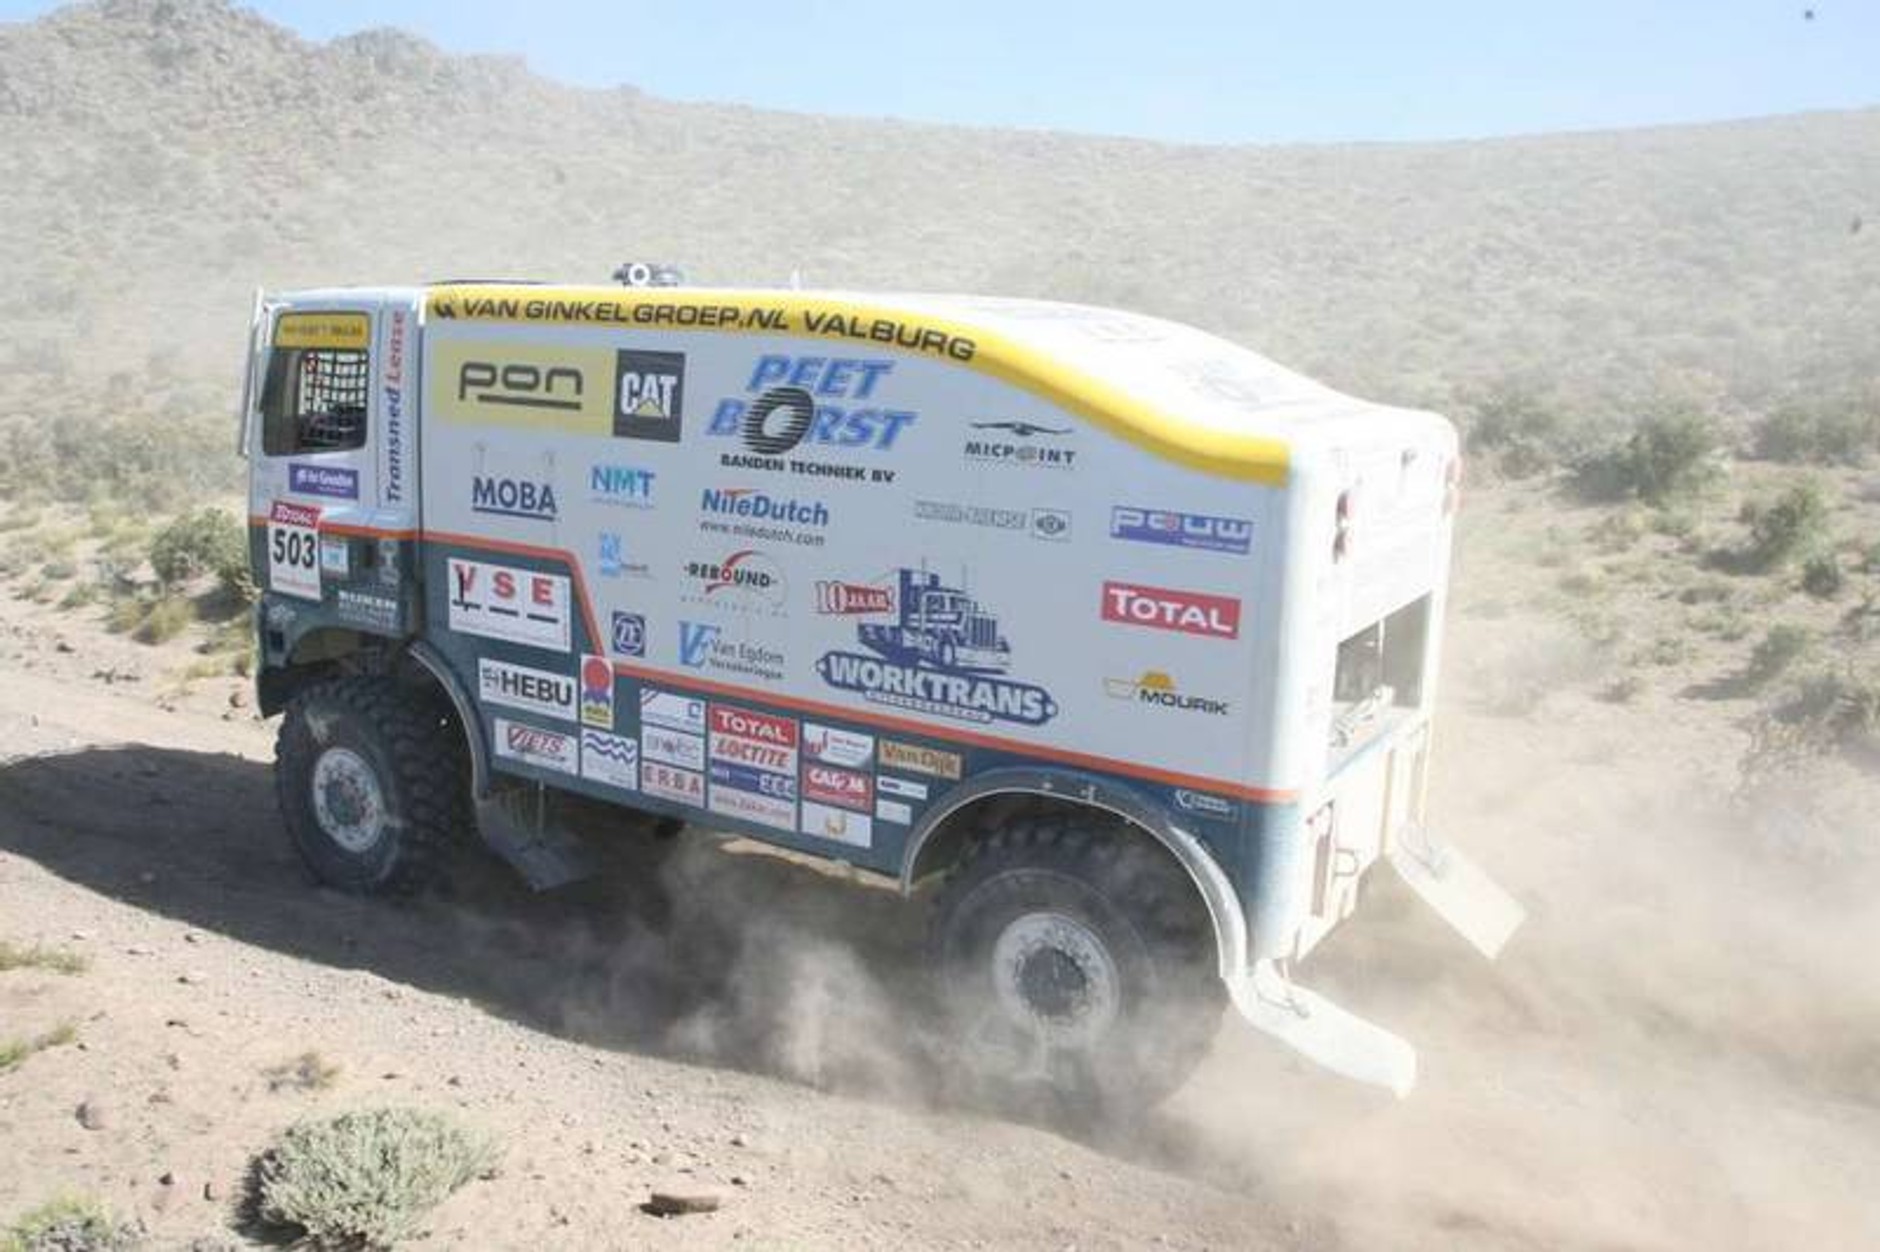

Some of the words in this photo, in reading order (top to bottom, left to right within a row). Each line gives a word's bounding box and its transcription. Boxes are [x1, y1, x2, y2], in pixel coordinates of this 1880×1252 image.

[386, 311, 406, 386] Lease
[463, 299, 518, 318] VAN
[525, 300, 627, 323] GINKEL
[633, 304, 789, 330] GROEP.NL
[803, 309, 976, 362] VALBURG
[620, 371, 678, 419] CAT
[747, 354, 895, 398] PEET
[384, 387, 405, 502] Transned
[591, 465, 656, 498] NMT
[720, 453, 785, 471] BANDEN
[790, 461, 867, 481] TECHNIEK
[871, 470, 896, 483] BV
[472, 475, 558, 514] MOBA
[701, 488, 829, 527] NileDutch
[272, 528, 316, 569] 503
[814, 579, 847, 614] 10
[1109, 588, 1234, 633] TOTAL
[501, 670, 573, 706] HEBU
[828, 654, 1044, 722] WORKTRANS
[1138, 687, 1230, 716] MOURIK
[715, 710, 789, 743] TOTAL
[715, 736, 790, 769] LOCTITE
